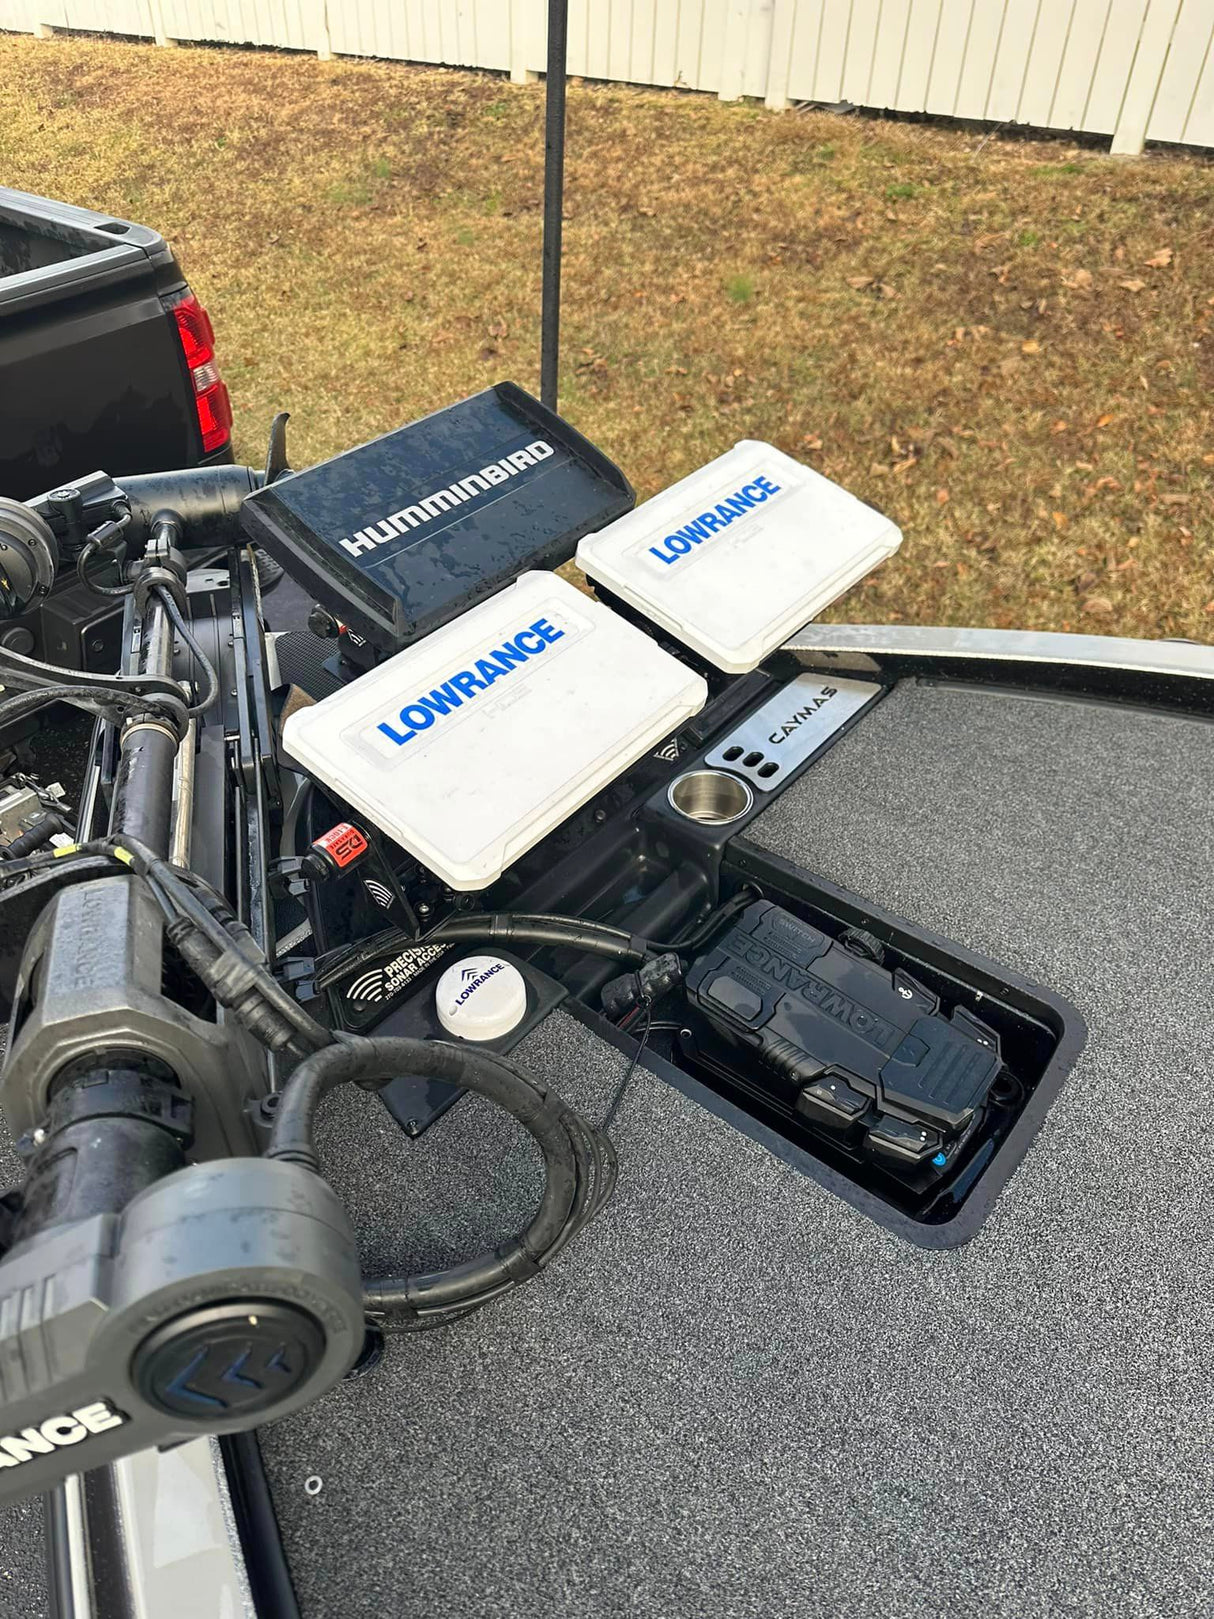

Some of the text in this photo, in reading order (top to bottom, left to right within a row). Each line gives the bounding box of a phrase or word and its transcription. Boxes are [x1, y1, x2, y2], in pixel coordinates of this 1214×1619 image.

[338, 440, 555, 558] HUMMINBIRD
[648, 475, 782, 565] LOWRANCE
[376, 617, 566, 746] LOWRANCE
[768, 686, 818, 744] CAYMAS
[384, 962, 419, 991] SONAR
[455, 963, 505, 1006] LOWRANCE
[726, 932, 897, 1048] LOWRANCE
